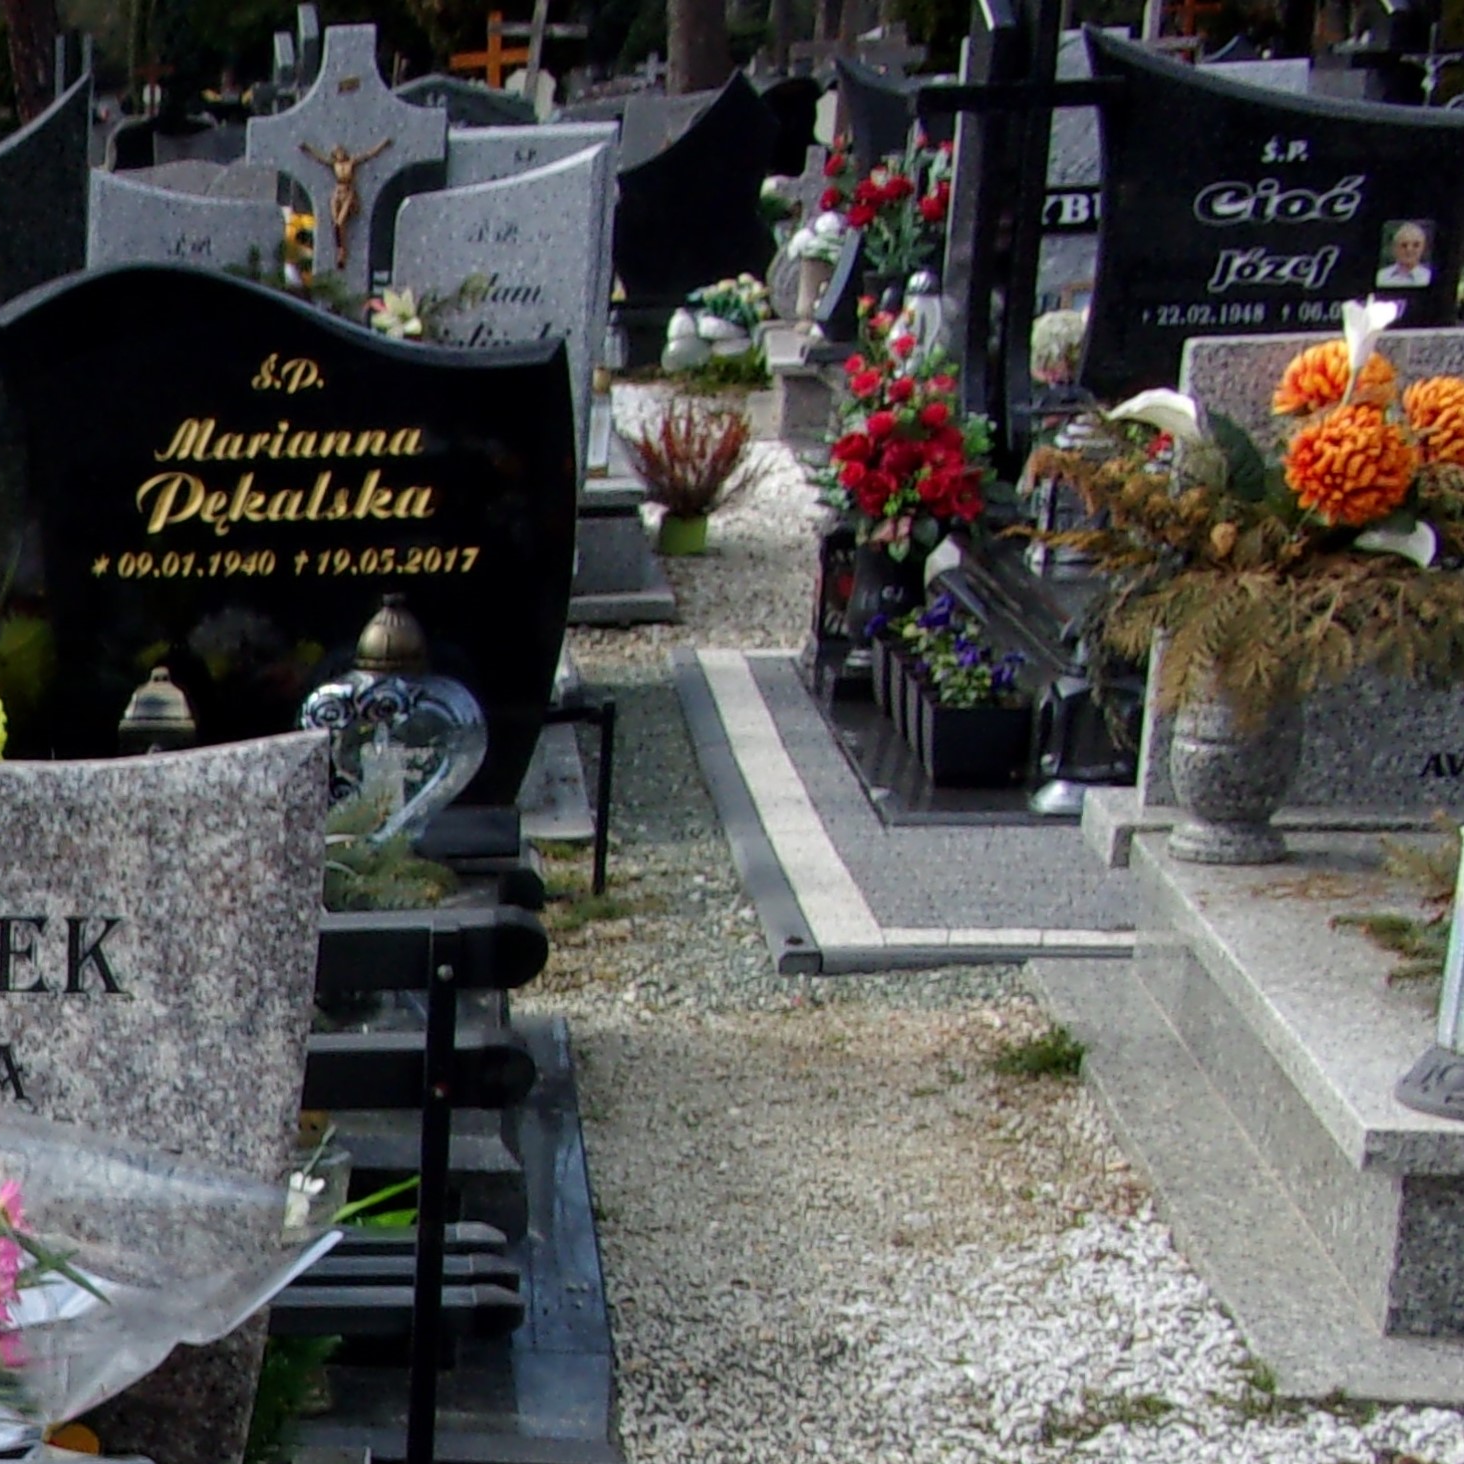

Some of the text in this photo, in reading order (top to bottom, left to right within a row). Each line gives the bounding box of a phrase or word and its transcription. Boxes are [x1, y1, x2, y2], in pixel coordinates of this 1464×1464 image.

[153, 417, 424, 462] Marianna
[135, 469, 436, 537] Pękalska
[117, 546, 481, 579] 09.01.1940 19.05.2017
